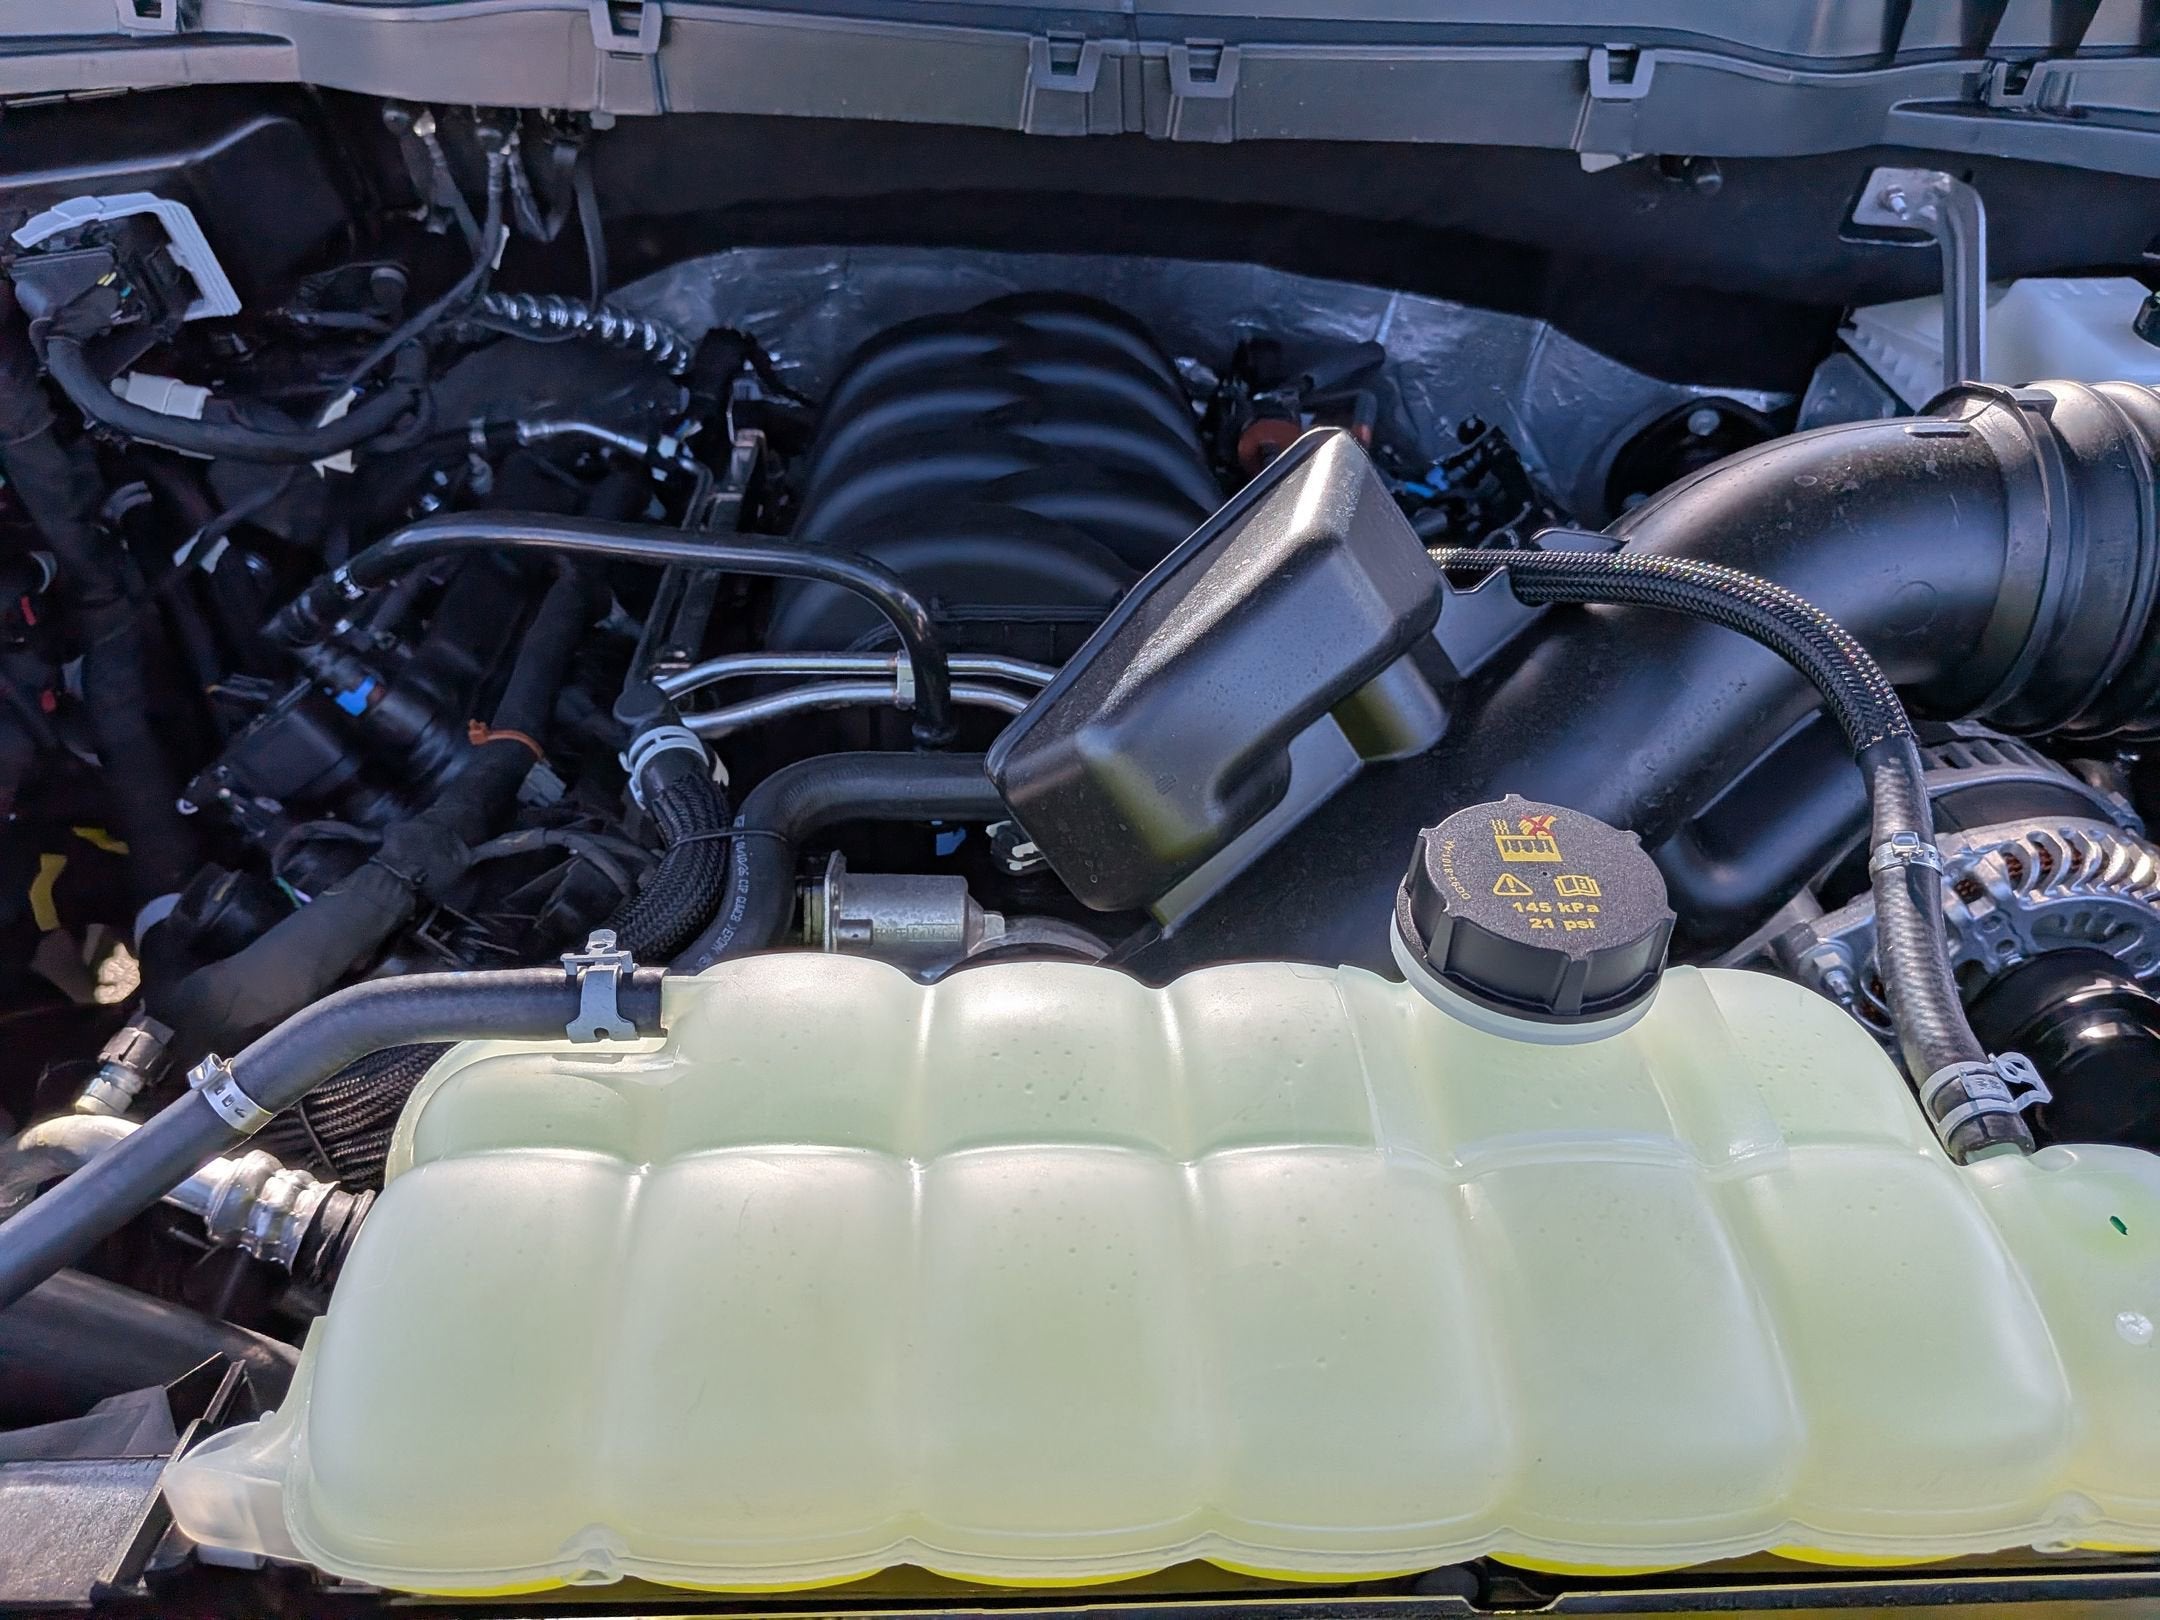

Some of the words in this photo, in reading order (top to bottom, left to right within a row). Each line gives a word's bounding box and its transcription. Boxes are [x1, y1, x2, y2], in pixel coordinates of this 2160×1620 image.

[1512, 901, 1552, 914] 145
[1558, 901, 1600, 914] kPa
[1529, 918, 1553, 929] 21
[1563, 917, 1596, 931] psi
